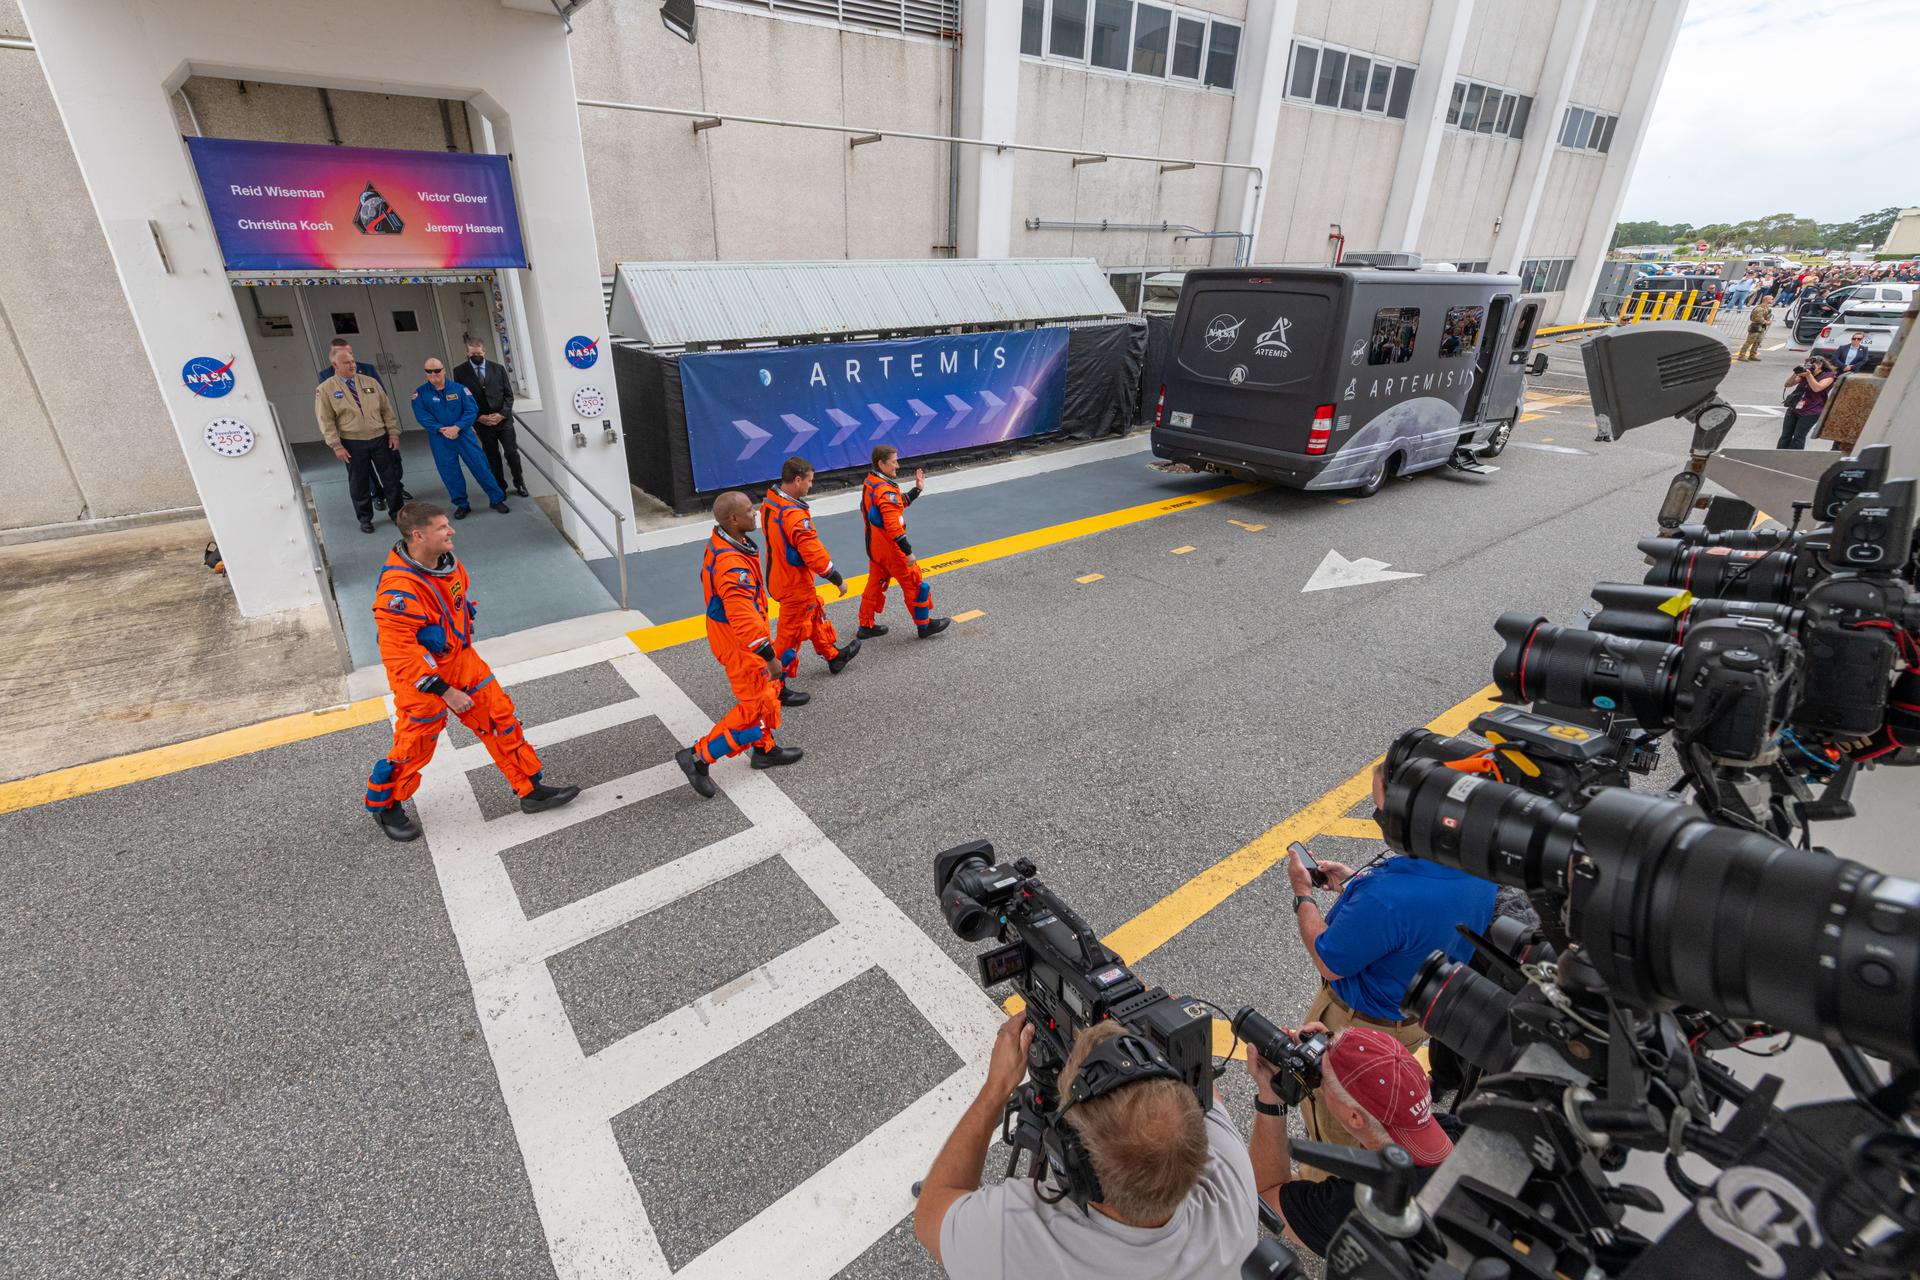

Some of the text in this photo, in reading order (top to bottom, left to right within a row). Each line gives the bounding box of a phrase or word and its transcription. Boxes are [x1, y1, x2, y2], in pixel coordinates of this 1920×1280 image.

[230, 184, 325, 199] Reid Wiseman
[417, 191, 488, 204] Victor Glover
[238, 218, 334, 231] Christina Koch
[425, 222, 504, 235] Jeremy Hansen
[1208, 328, 1236, 339] NASA
[567, 348, 597, 358] NASA
[1255, 348, 1289, 359] ARTEMIS
[809, 346, 1006, 388] ARTEMIS
[186, 371, 233, 384] NASA
[1369, 370, 1454, 398] ARTEMIS
[582, 399, 599, 409] 250
[217, 434, 243, 447] 250
[931, 557, 970, 571] PARKING
